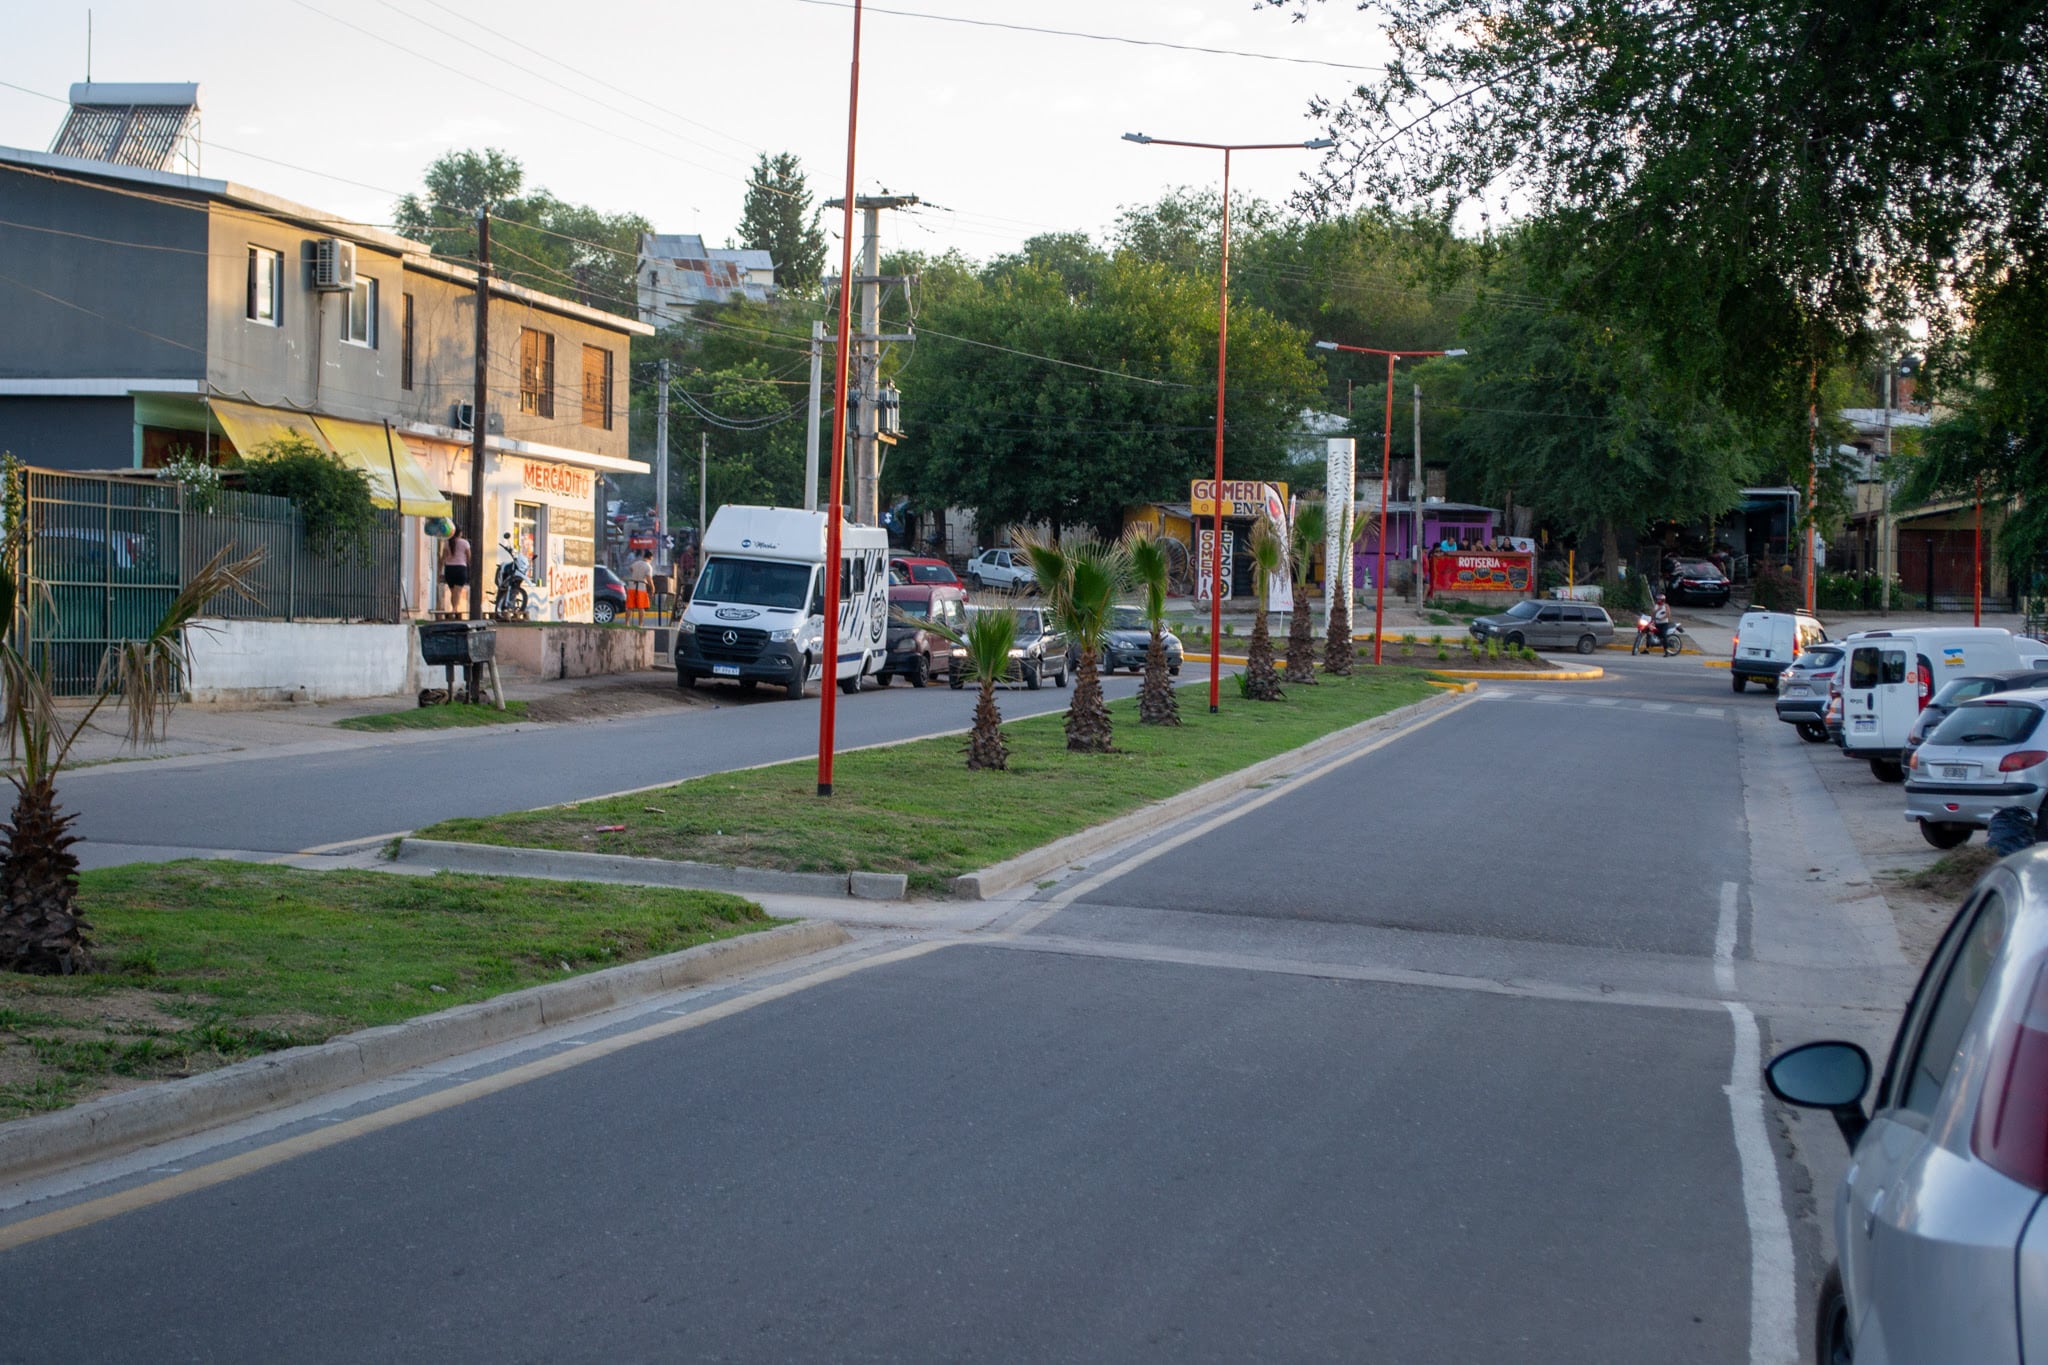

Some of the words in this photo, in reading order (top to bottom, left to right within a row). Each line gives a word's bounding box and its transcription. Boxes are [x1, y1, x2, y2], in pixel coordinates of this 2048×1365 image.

[524, 463, 589, 498] MERCADITO
[1194, 481, 1279, 500] GOMERI
[1233, 502, 1266, 514] ENZ
[1200, 531, 1213, 599] GOMERIA
[1221, 532, 1232, 577] ENZO
[1458, 557, 1501, 568] ROTISERIA
[555, 570, 578, 595] Calidad
[579, 573, 588, 590] en
[557, 593, 591, 619] CARNES
